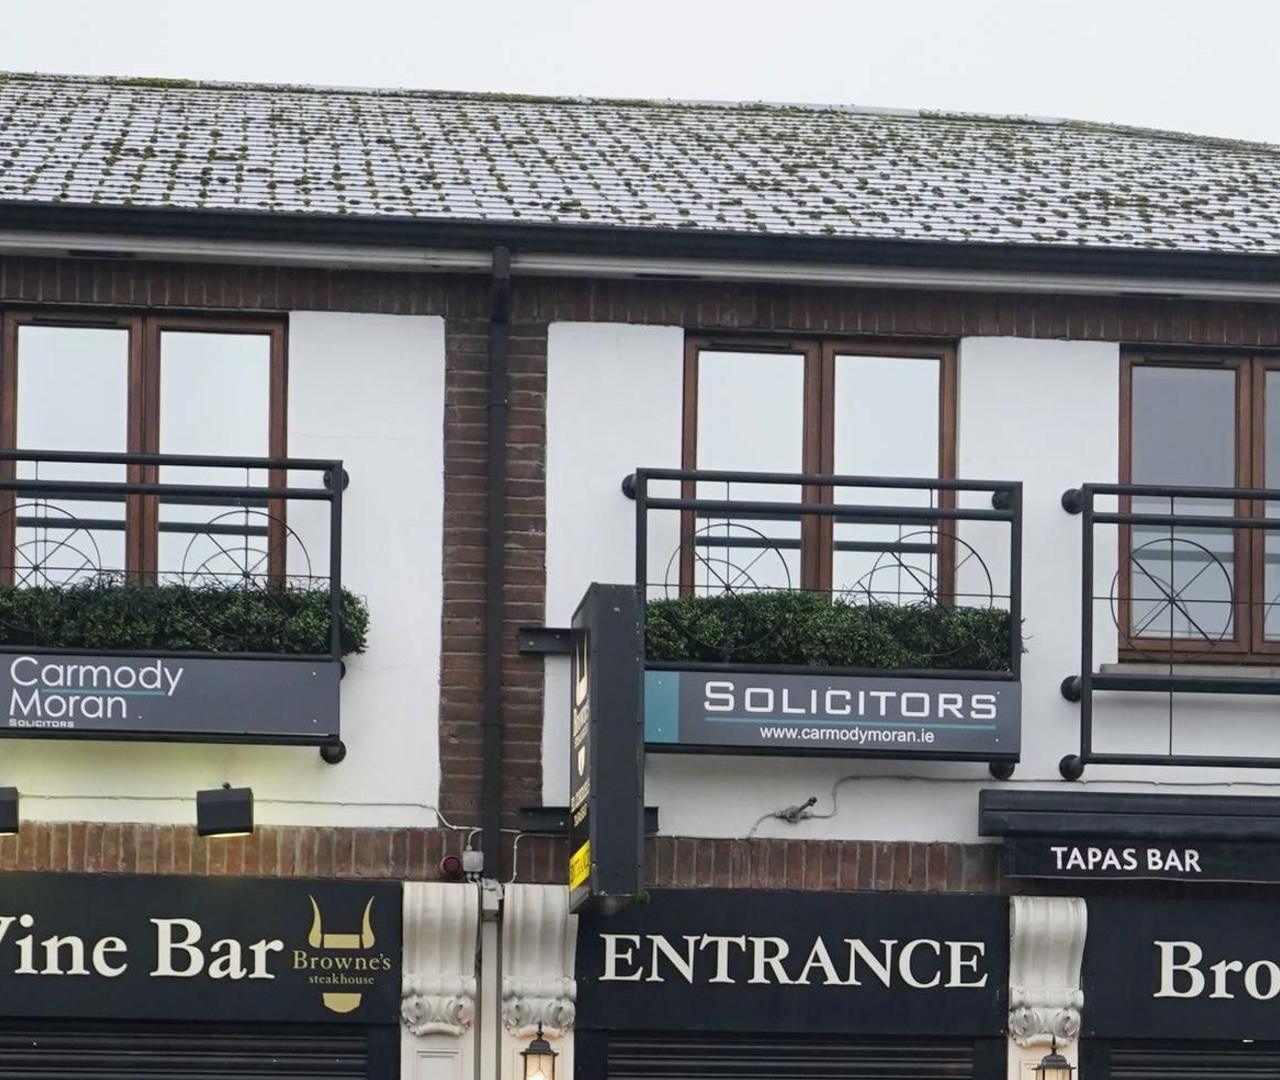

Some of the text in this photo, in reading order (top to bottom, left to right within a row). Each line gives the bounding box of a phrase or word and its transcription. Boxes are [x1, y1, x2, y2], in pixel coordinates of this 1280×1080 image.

[10, 656, 184, 697] Carmody
[9, 688, 127, 719] Moran
[704, 681, 997, 720] SOLICITORS
[760, 727, 935, 745] www.carmodymoran.ie
[1050, 846, 1202, 872] TAPAS BAR
[149, 918, 285, 980] Bar
[292, 950, 392, 971] Browne's
[597, 932, 989, 989] ENTRANCE
[308, 973, 375, 985] steakhouse
